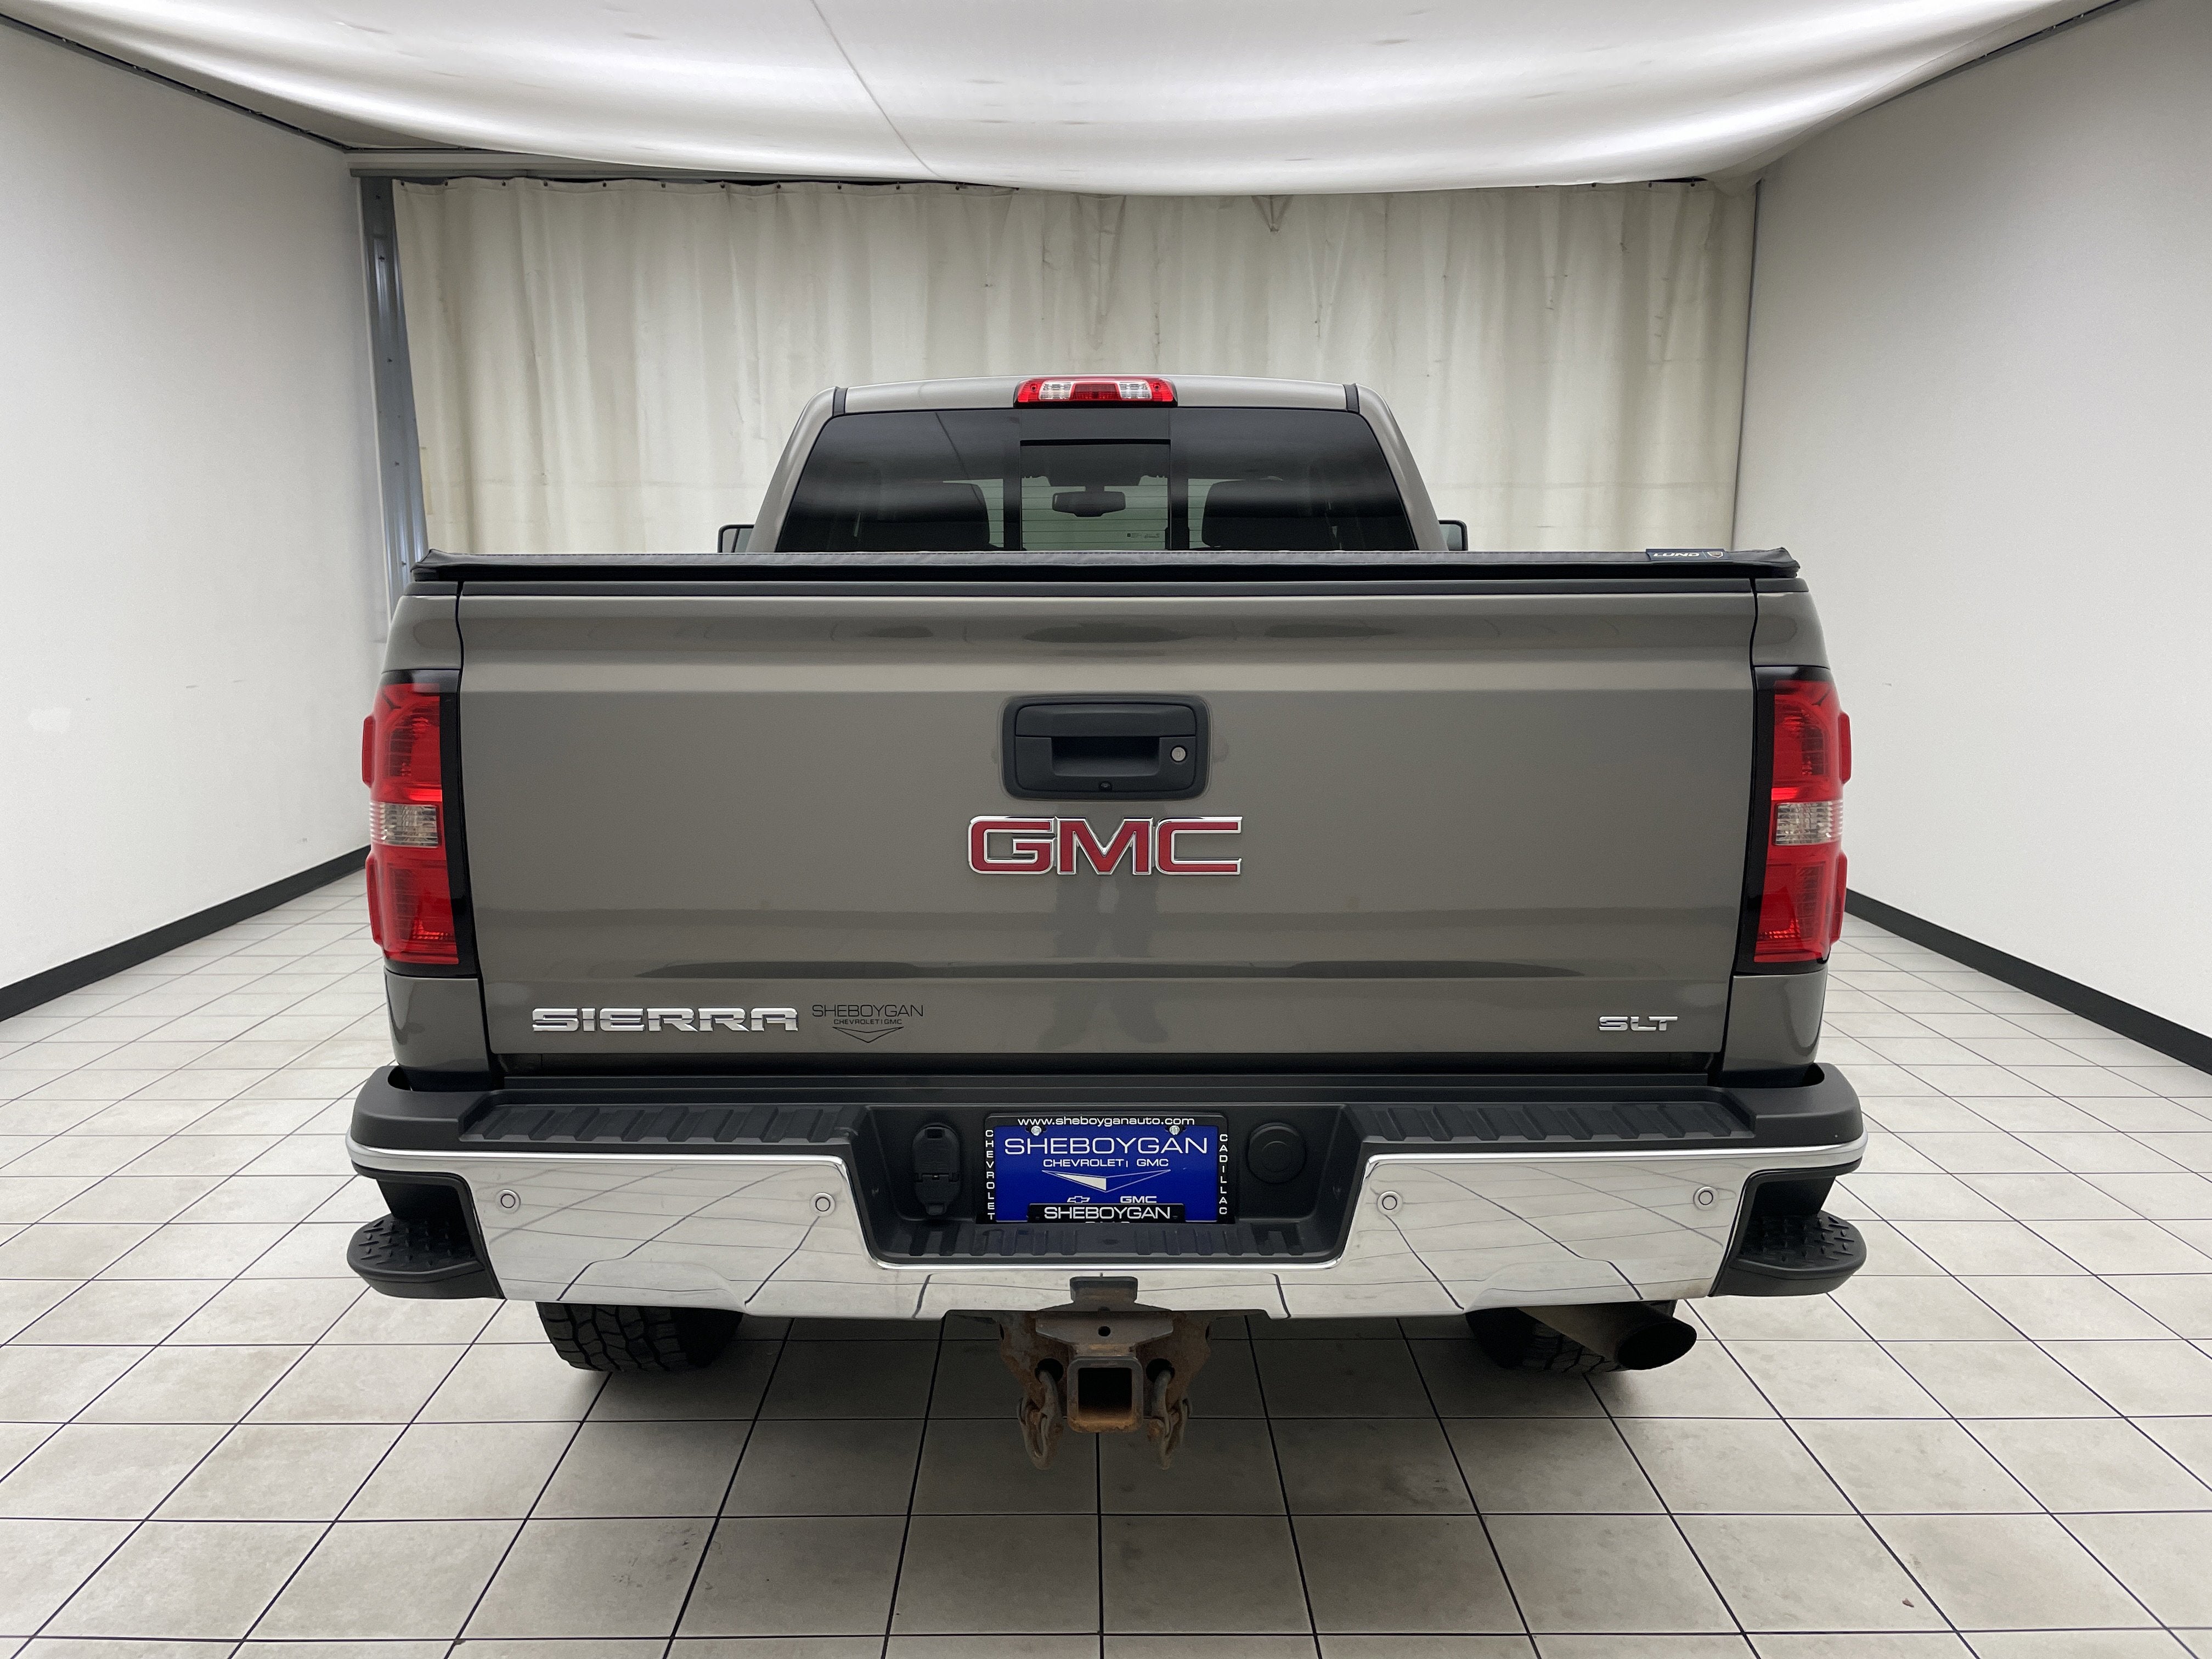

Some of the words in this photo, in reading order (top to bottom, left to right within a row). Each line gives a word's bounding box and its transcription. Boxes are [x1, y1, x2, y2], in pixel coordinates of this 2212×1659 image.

[968, 815, 1243, 875] GMC
[812, 1005, 924, 1017] SHEBOYGAN
[532, 1007, 799, 1032] SIERRA
[1599, 1016, 1678, 1031] SLT
[1017, 1116, 1195, 1127] www.sheboyganauto.com
[1004, 1137, 1207, 1155] SHEBOYGAN
[1043, 1159, 1125, 1167] CHEVROLET
[1136, 1159, 1169, 1167] GMC
[985, 1129, 995, 1220] CHEVROLET
[1218, 1133, 1228, 1215] CADILLAC
[1120, 1195, 1157, 1204] GMC
[1044, 1206, 1170, 1219] SHEBOYGAN
